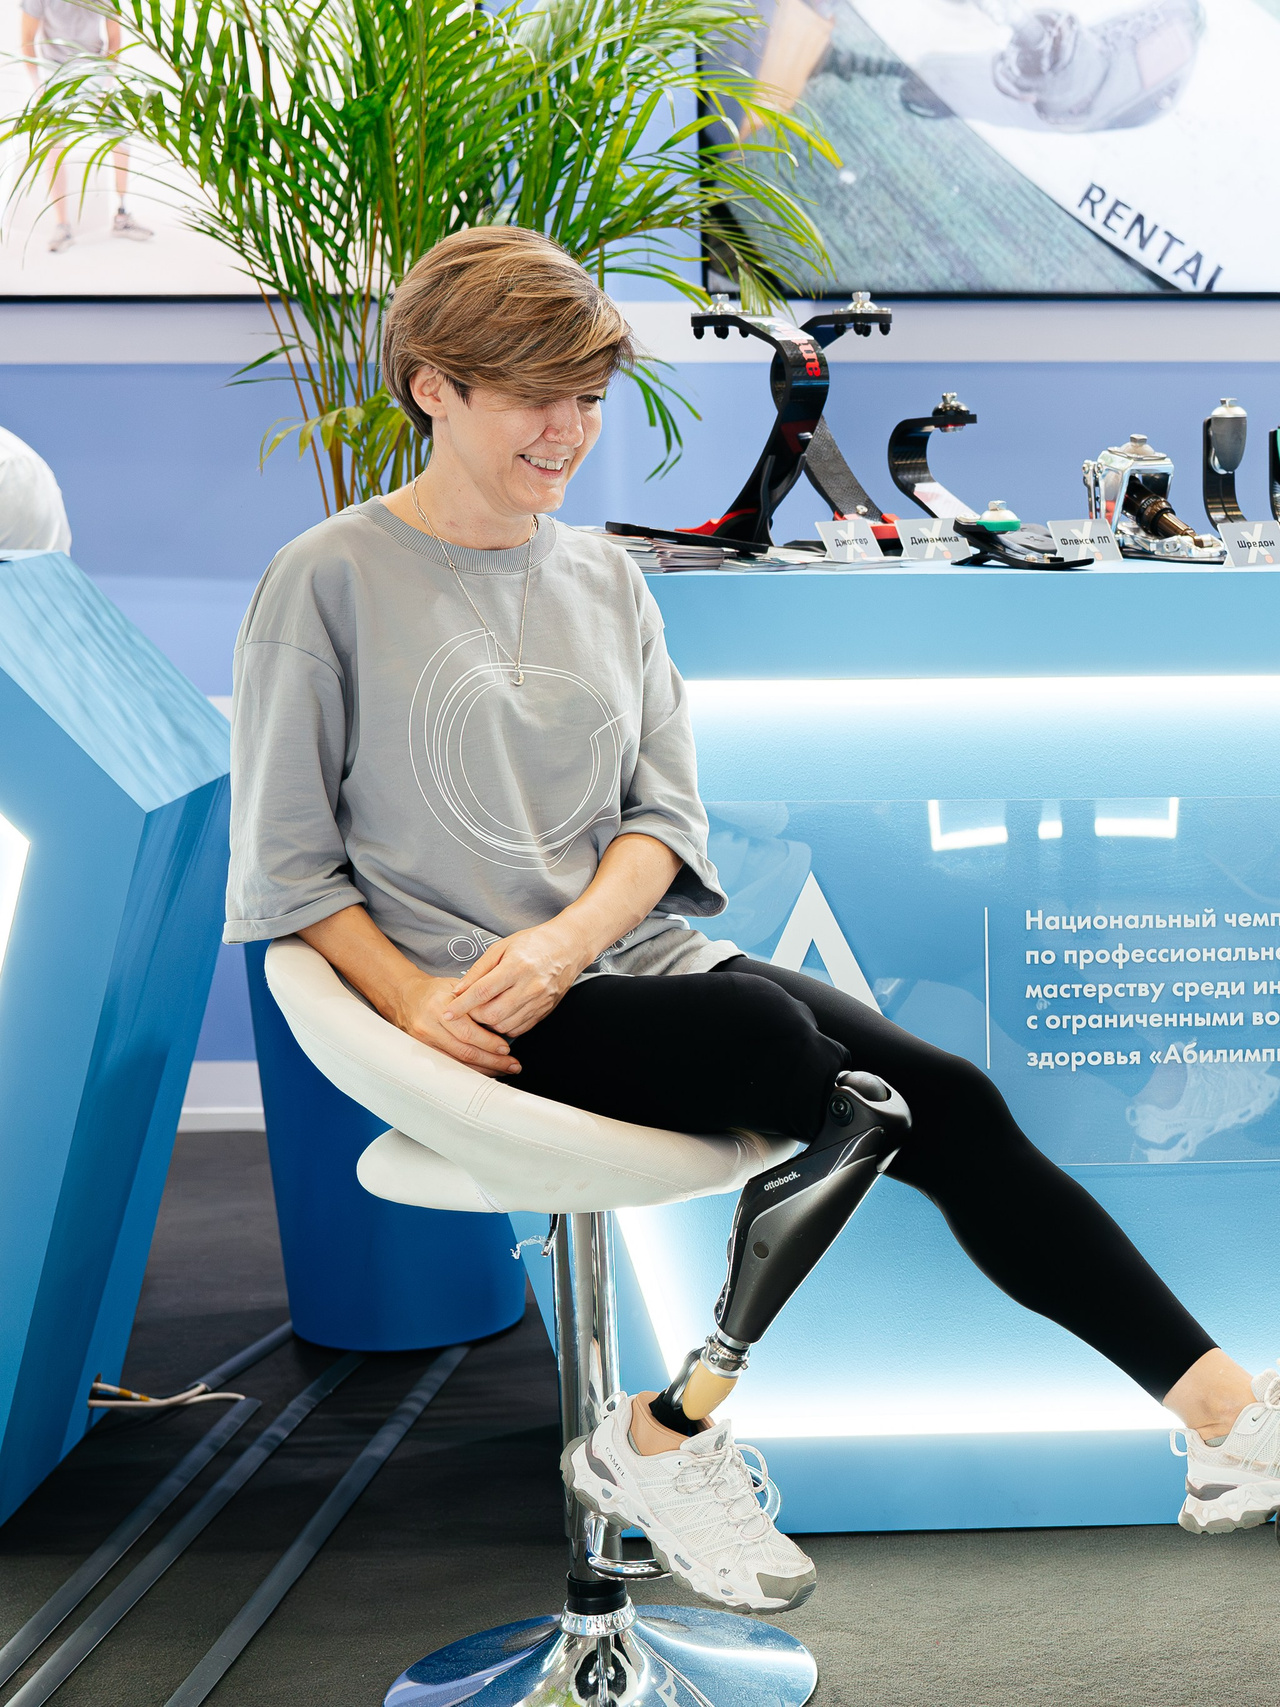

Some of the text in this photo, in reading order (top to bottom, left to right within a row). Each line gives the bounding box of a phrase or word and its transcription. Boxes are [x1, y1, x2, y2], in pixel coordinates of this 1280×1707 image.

[834, 537, 869, 548] Джоггер
[910, 536, 960, 546] Динамика
[1060, 537, 1096, 546] Флекси
[1236, 539, 1276, 549] Шредон
[1025, 907, 1217, 933] Национальный
[1025, 950, 1056, 964] по
[1025, 982, 1166, 1004] мастерству
[1172, 981, 1246, 1003] среди
[1026, 1015, 1039, 1030] с
[1045, 1011, 1245, 1035] ограниченными
[1026, 1050, 1141, 1072] здоровья
[605, 1447, 625, 1479] CAMEL
